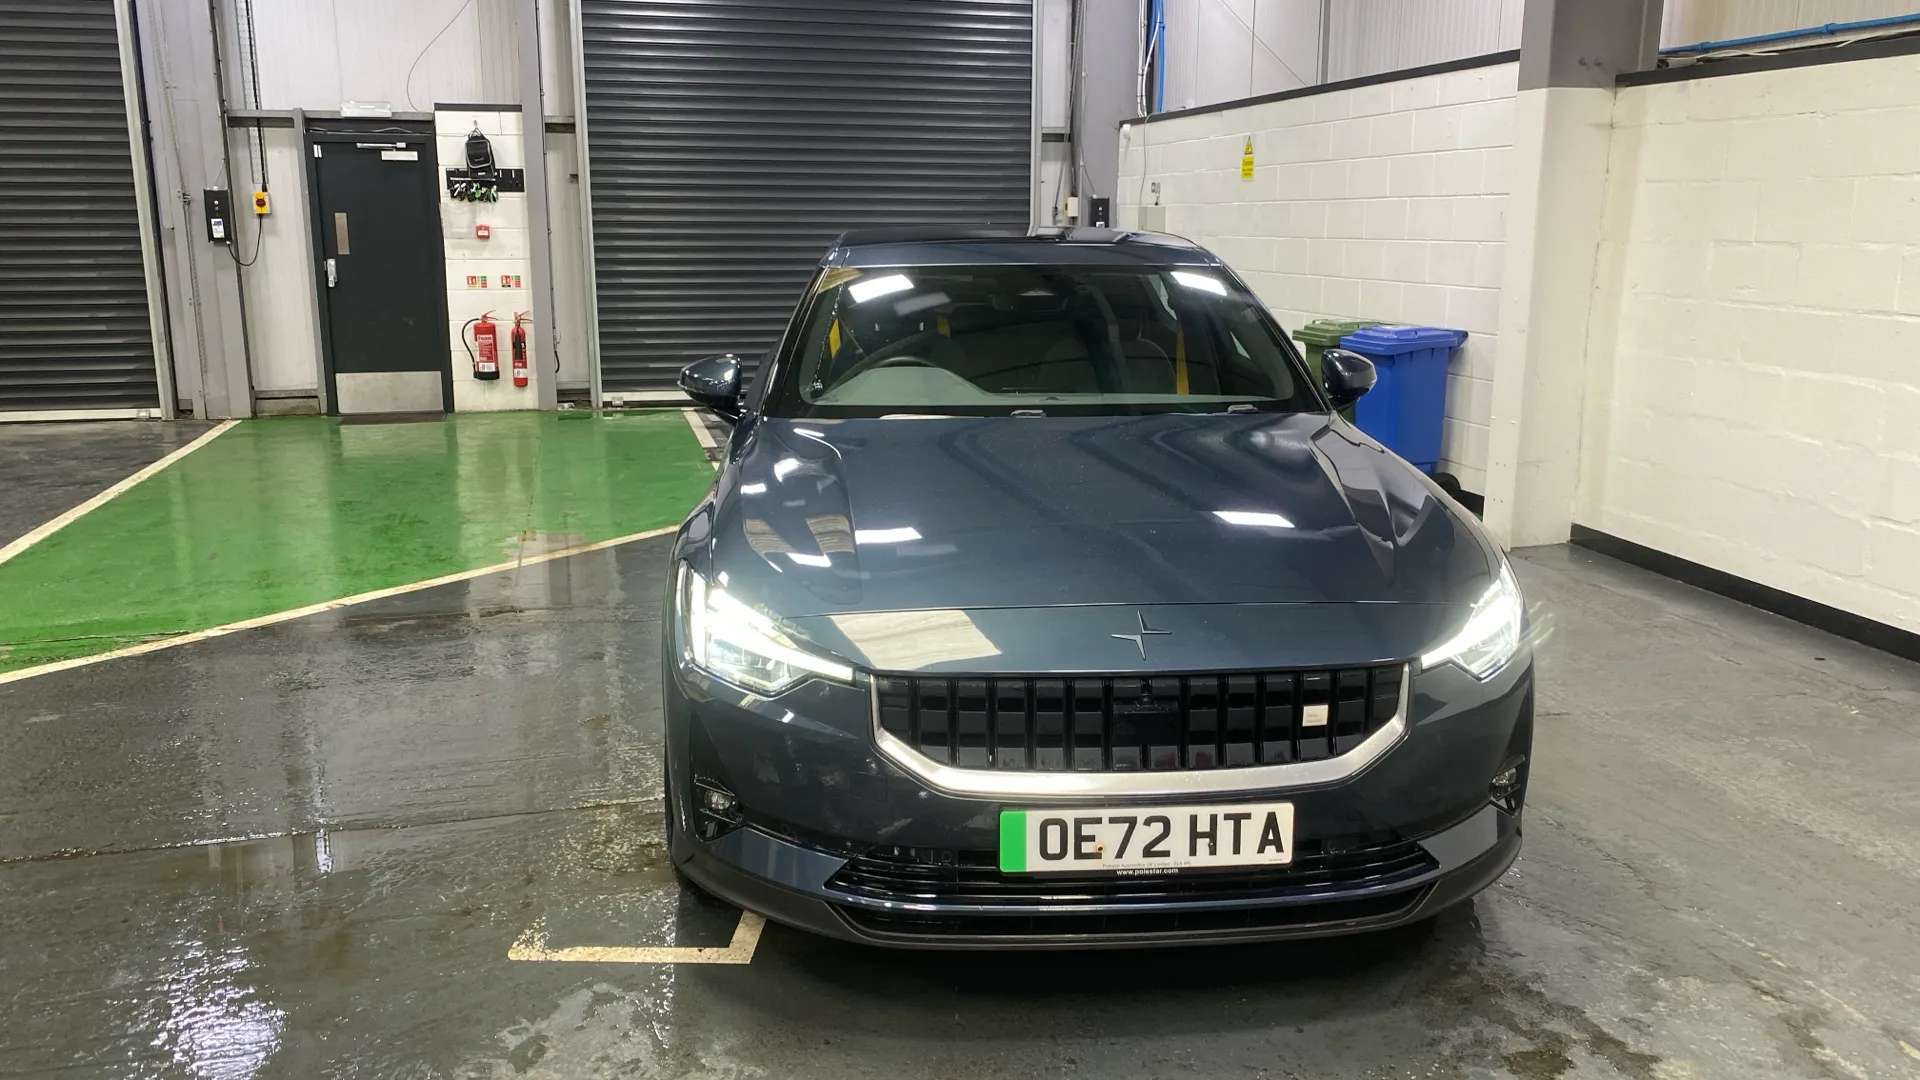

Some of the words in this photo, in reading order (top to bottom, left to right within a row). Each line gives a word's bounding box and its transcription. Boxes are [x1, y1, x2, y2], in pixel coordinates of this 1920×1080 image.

[1039, 815, 1171, 861] OE72
[1189, 811, 1284, 857] HTA
[1116, 868, 1179, 876] www.polestar.com
